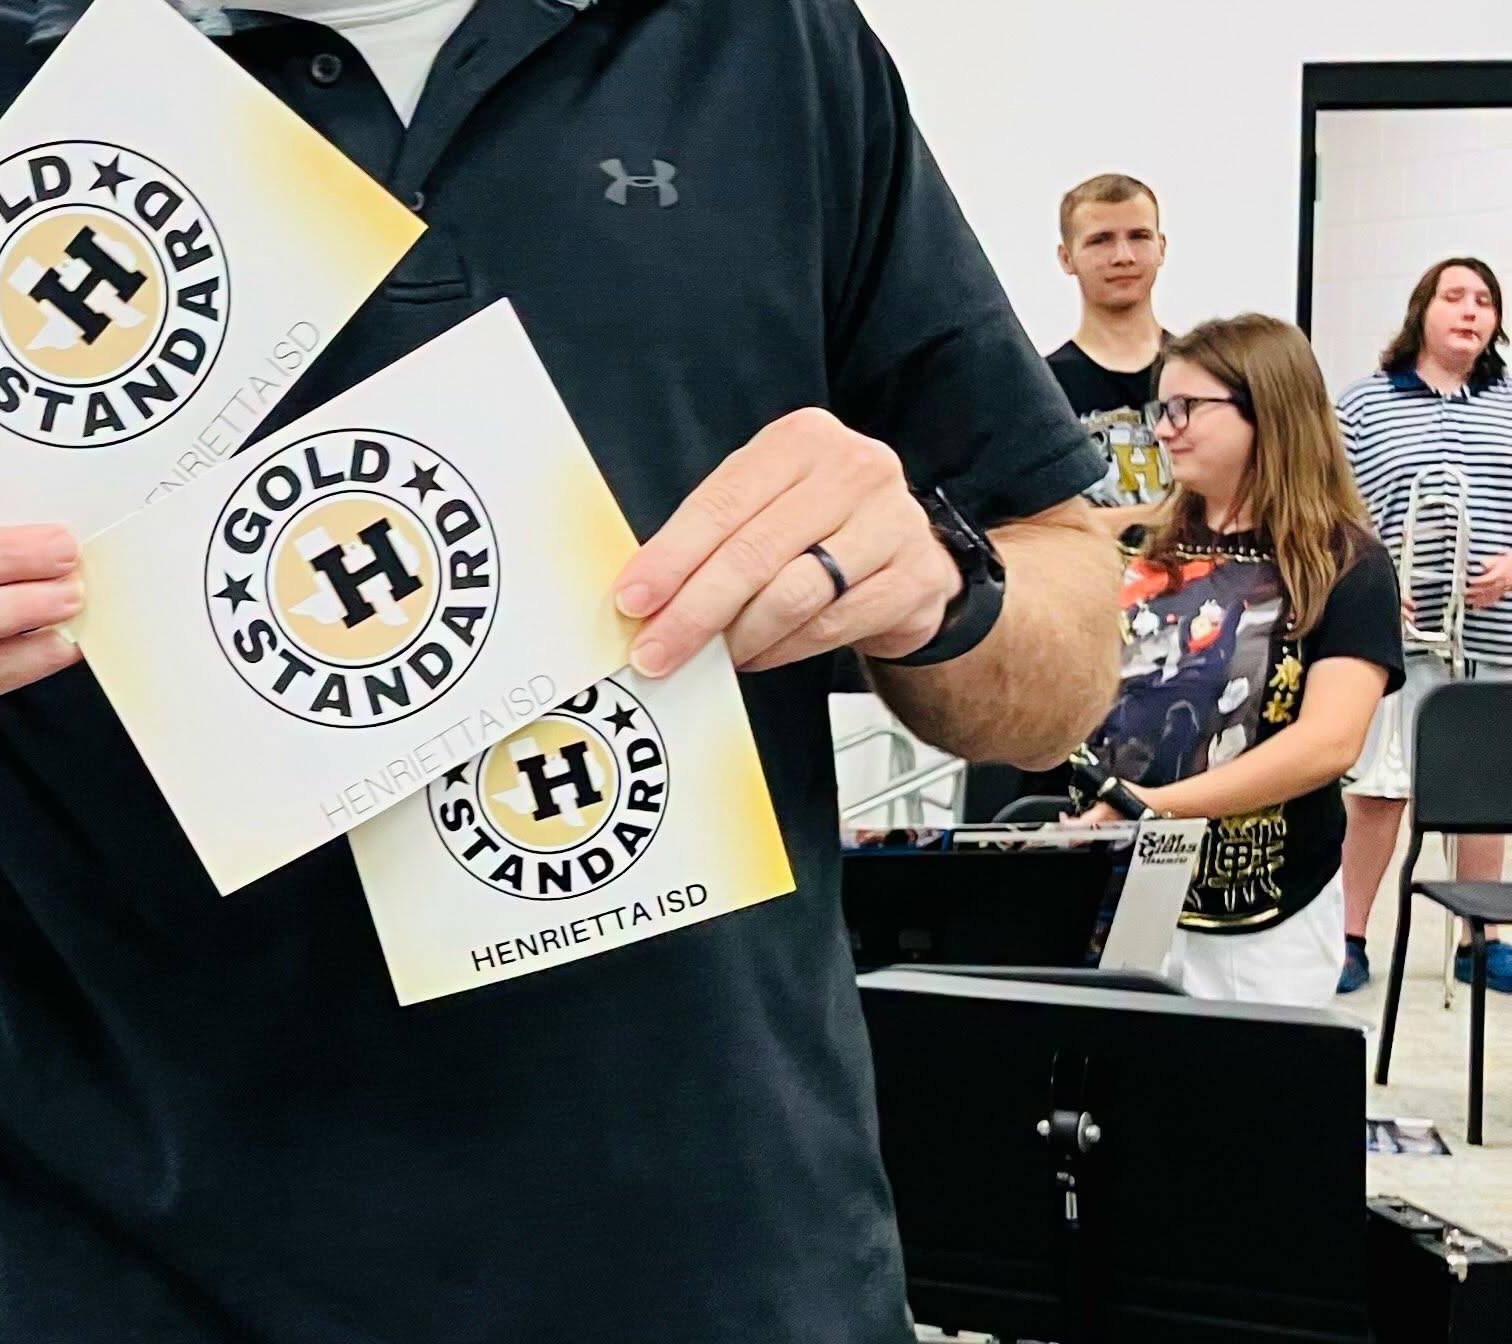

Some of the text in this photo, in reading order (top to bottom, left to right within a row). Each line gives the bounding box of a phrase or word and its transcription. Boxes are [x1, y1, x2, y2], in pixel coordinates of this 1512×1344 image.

[28, 225, 148, 346] H
[144, 320, 321, 508] NRIETTA ISD
[224, 439, 390, 554] GOLD
[233, 498, 491, 718] STANDARD
[310, 517, 424, 630] H
[319, 673, 557, 829] HENRIETTA ISD
[517, 740, 603, 822] H
[440, 737, 665, 895] STANDARD
[471, 883, 708, 972] HENRIETTA ISD
